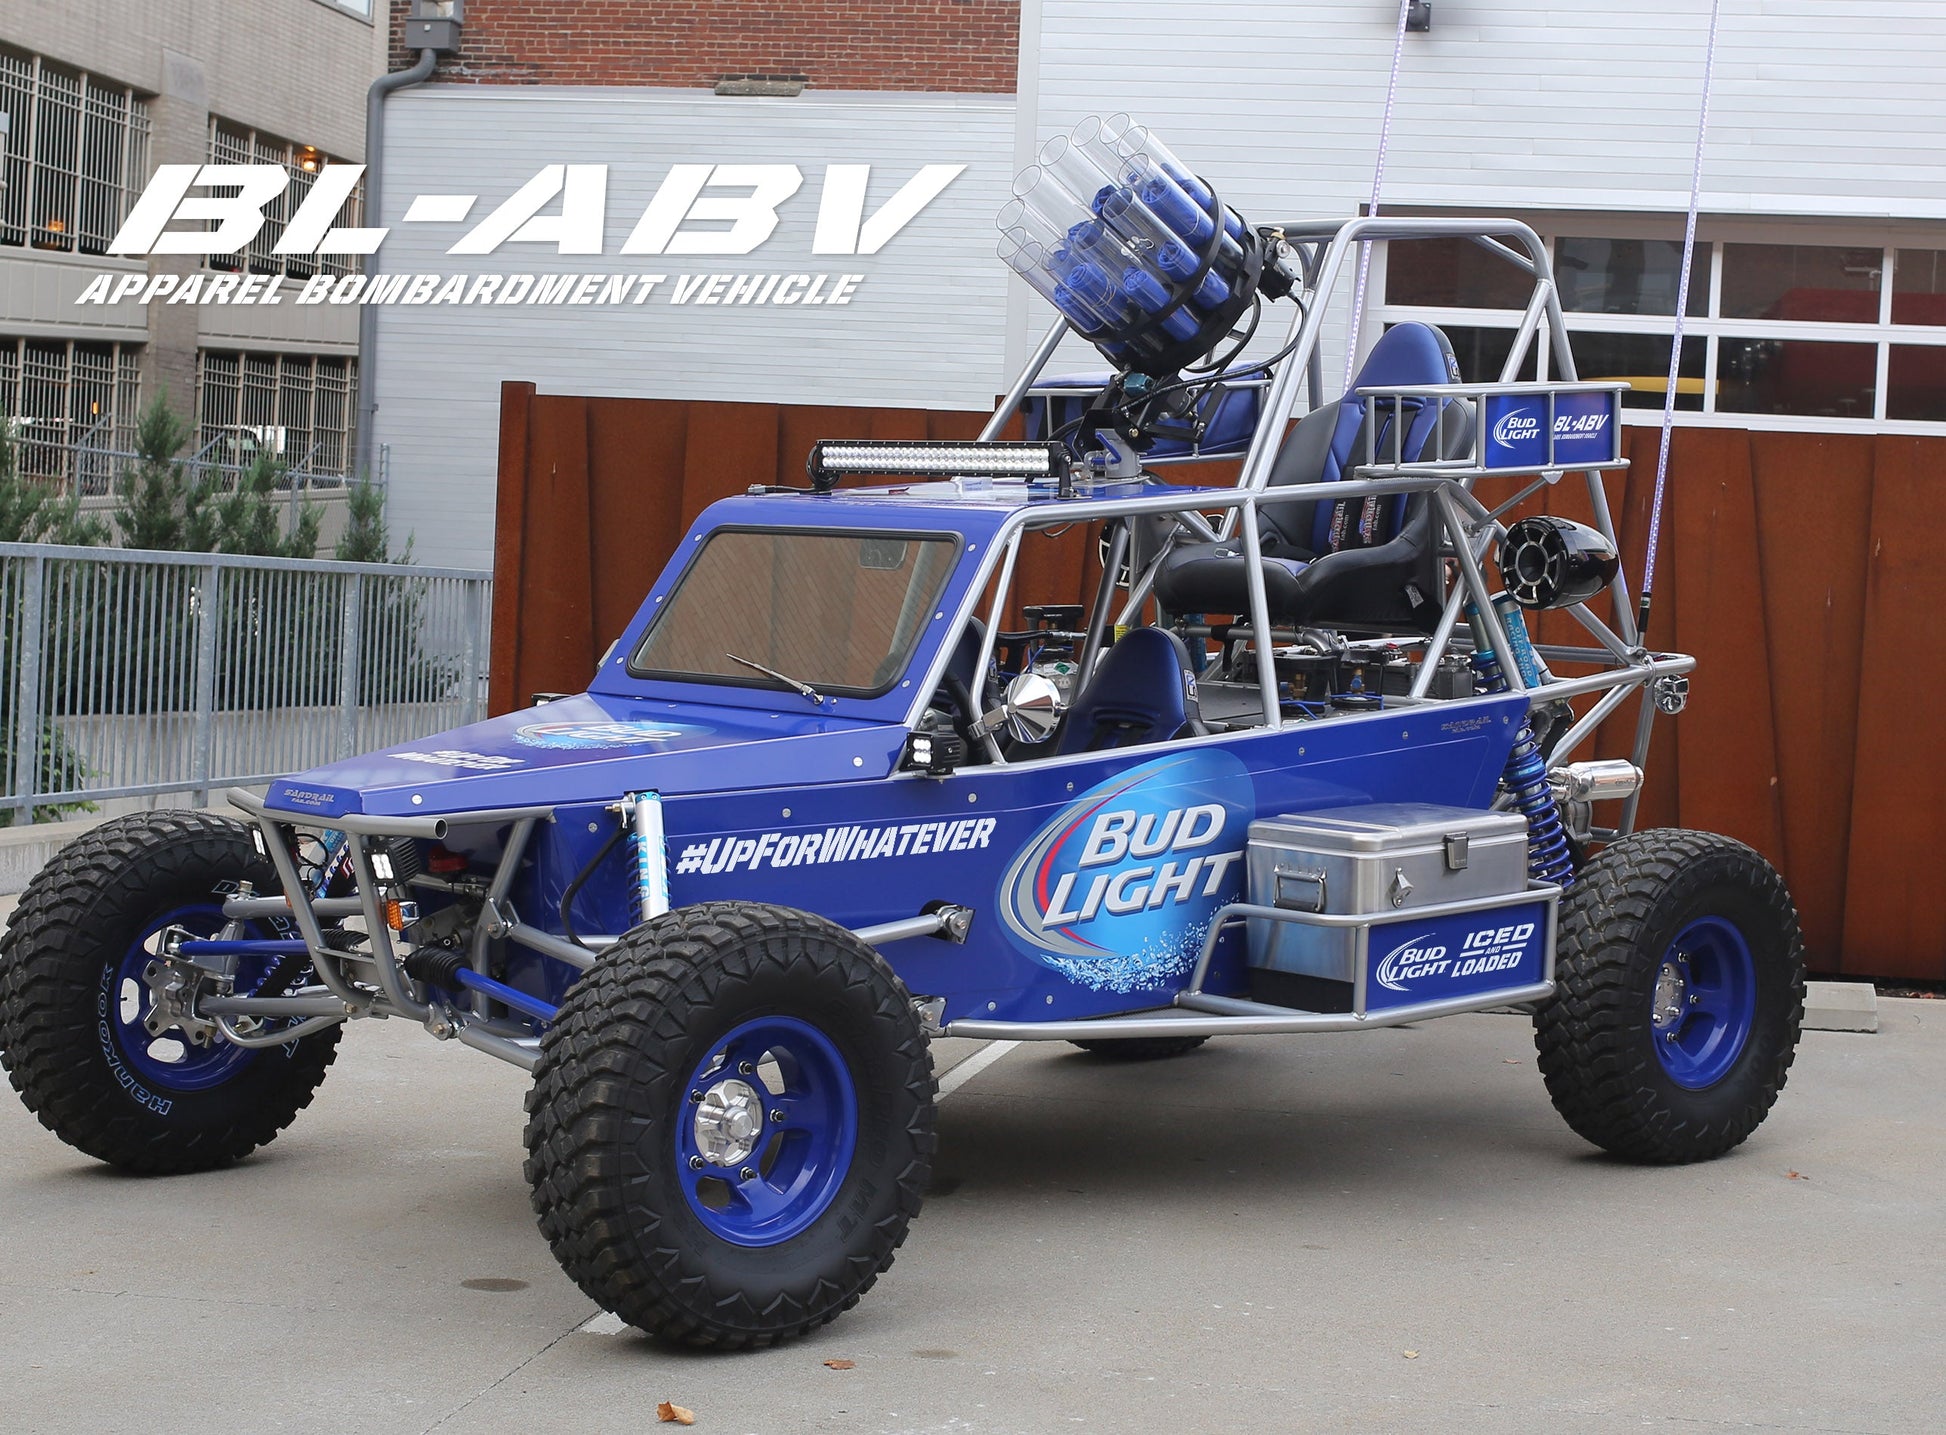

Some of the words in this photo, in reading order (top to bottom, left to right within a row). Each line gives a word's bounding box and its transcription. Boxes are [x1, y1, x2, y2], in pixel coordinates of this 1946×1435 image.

[1500, 428, 1540, 440] LIGHT
[1507, 417, 1537, 429] BUD
[1553, 414, 1610, 432] BL-ABV
[1076, 801, 1227, 869] BUD
[1041, 850, 1246, 933] LIGHT
[1462, 922, 1535, 950] ICED
[1398, 946, 1447, 966] BUD
[1485, 946, 1501, 955] AND
[1387, 959, 1452, 983] LIGHT
[1451, 951, 1523, 978] LOADED
